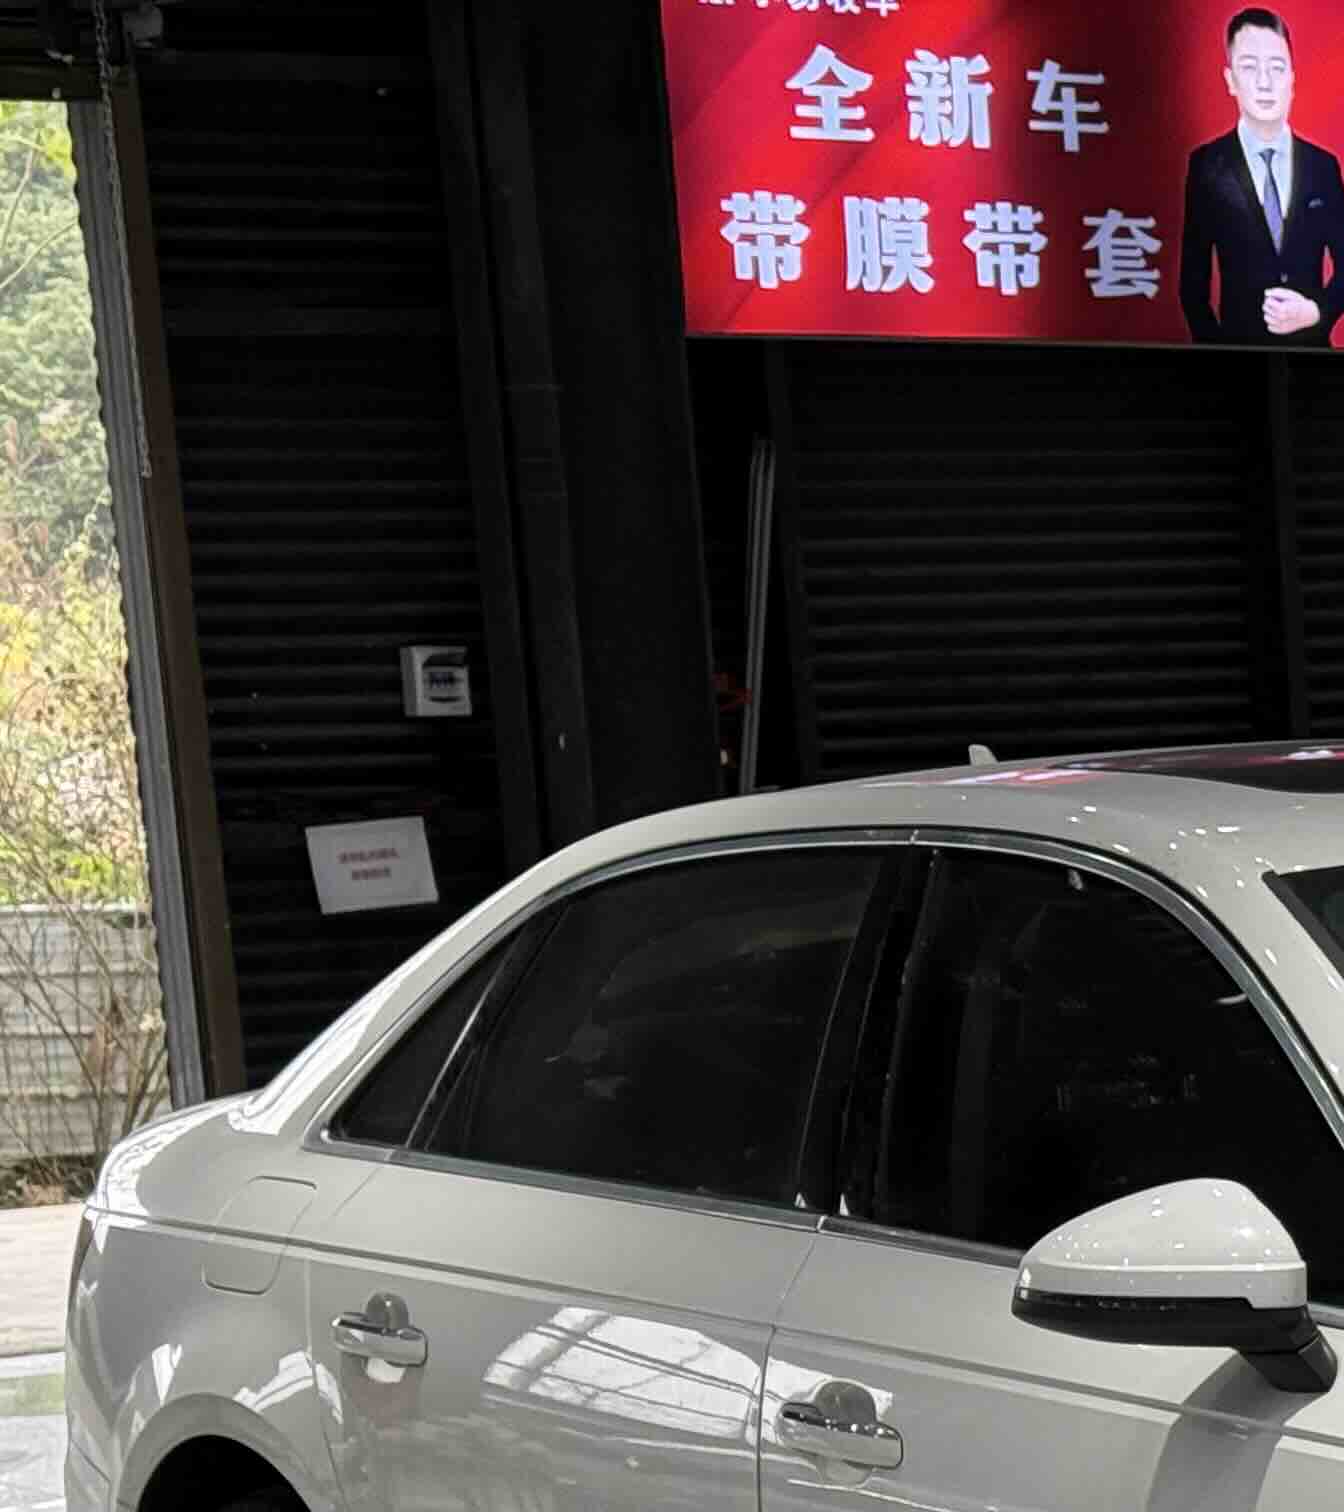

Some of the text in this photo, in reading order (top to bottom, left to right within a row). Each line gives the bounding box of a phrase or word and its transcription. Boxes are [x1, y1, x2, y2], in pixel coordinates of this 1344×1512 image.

[785, 43, 1109, 152] 全新车
[720, 191, 1163, 299] 带膜带套
